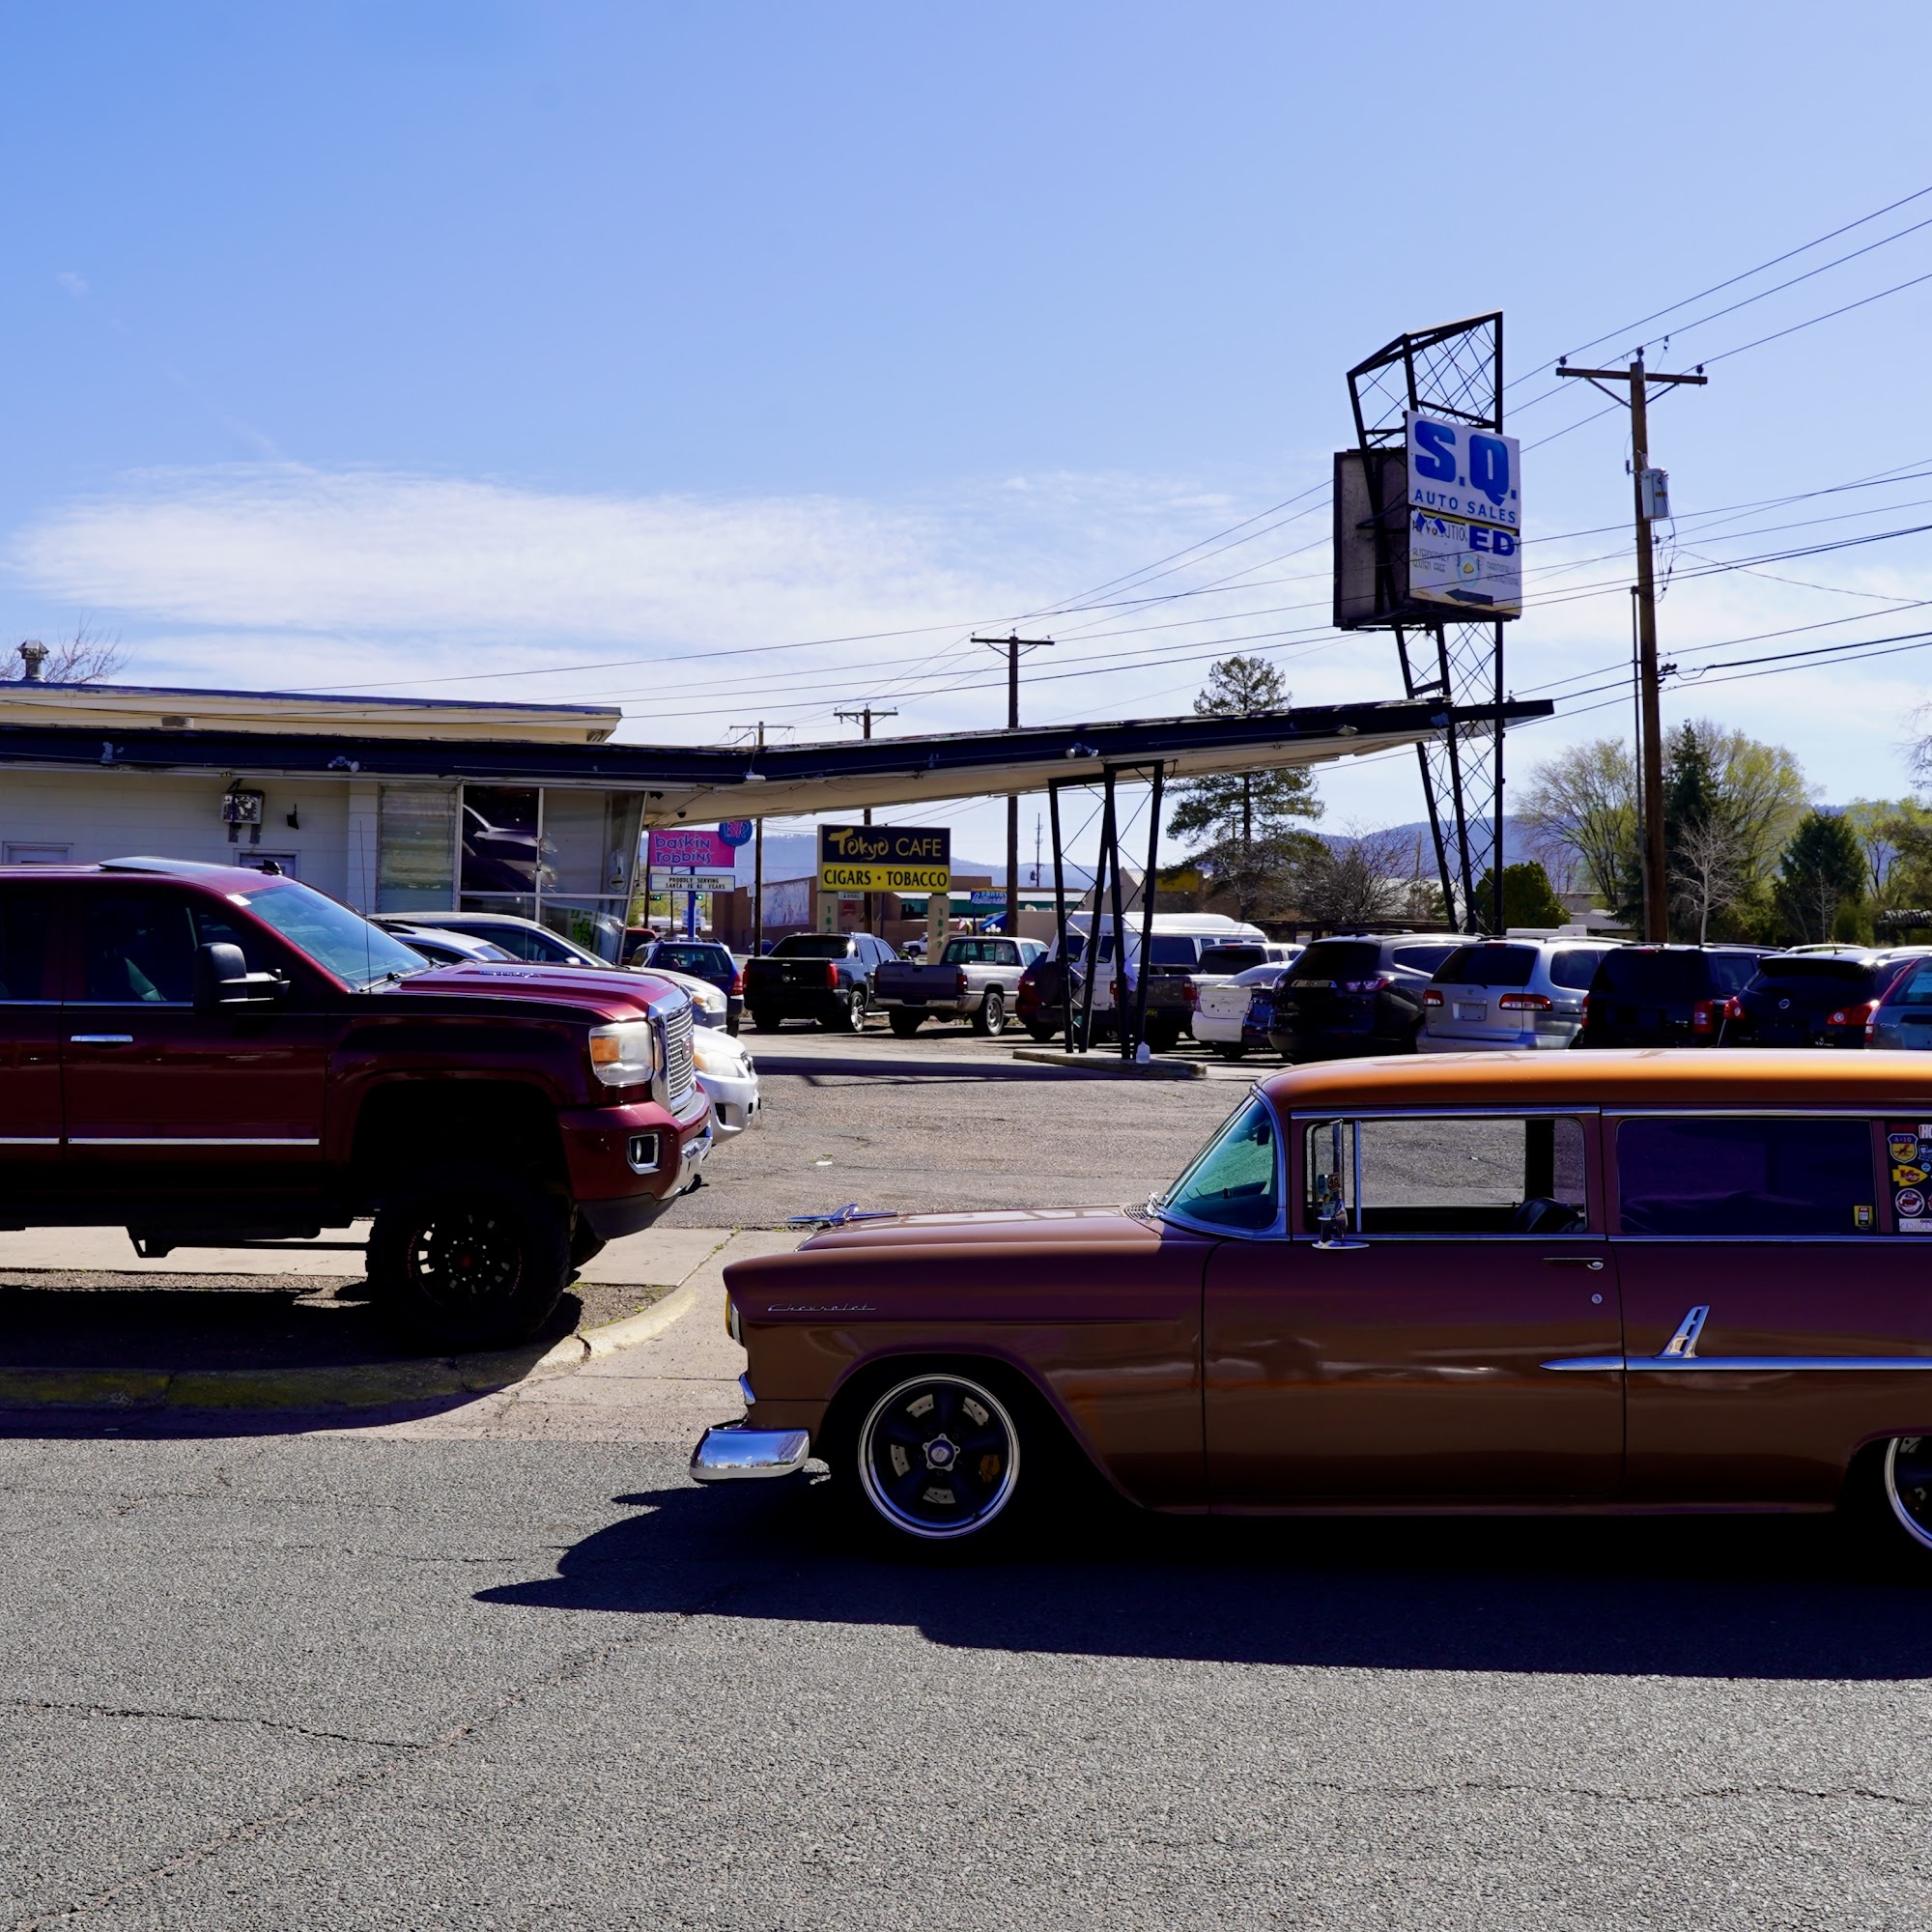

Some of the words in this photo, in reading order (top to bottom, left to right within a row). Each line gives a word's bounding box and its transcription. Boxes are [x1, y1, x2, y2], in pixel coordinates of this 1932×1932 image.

[1415, 420, 1518, 507] S.Q.
[1414, 489, 1459, 510] AUTO
[1467, 501, 1516, 524] SALES
[1469, 525, 1516, 556] ED
[654, 834, 710, 850] baskin
[828, 828, 889, 862] Tokyo
[895, 838, 941, 857] CAFE
[656, 850, 711, 865] robbins
[824, 869, 871, 885] CIGARS
[887, 871, 947, 887] TOBACCO
[767, 1302, 878, 1312] Chevrolet
